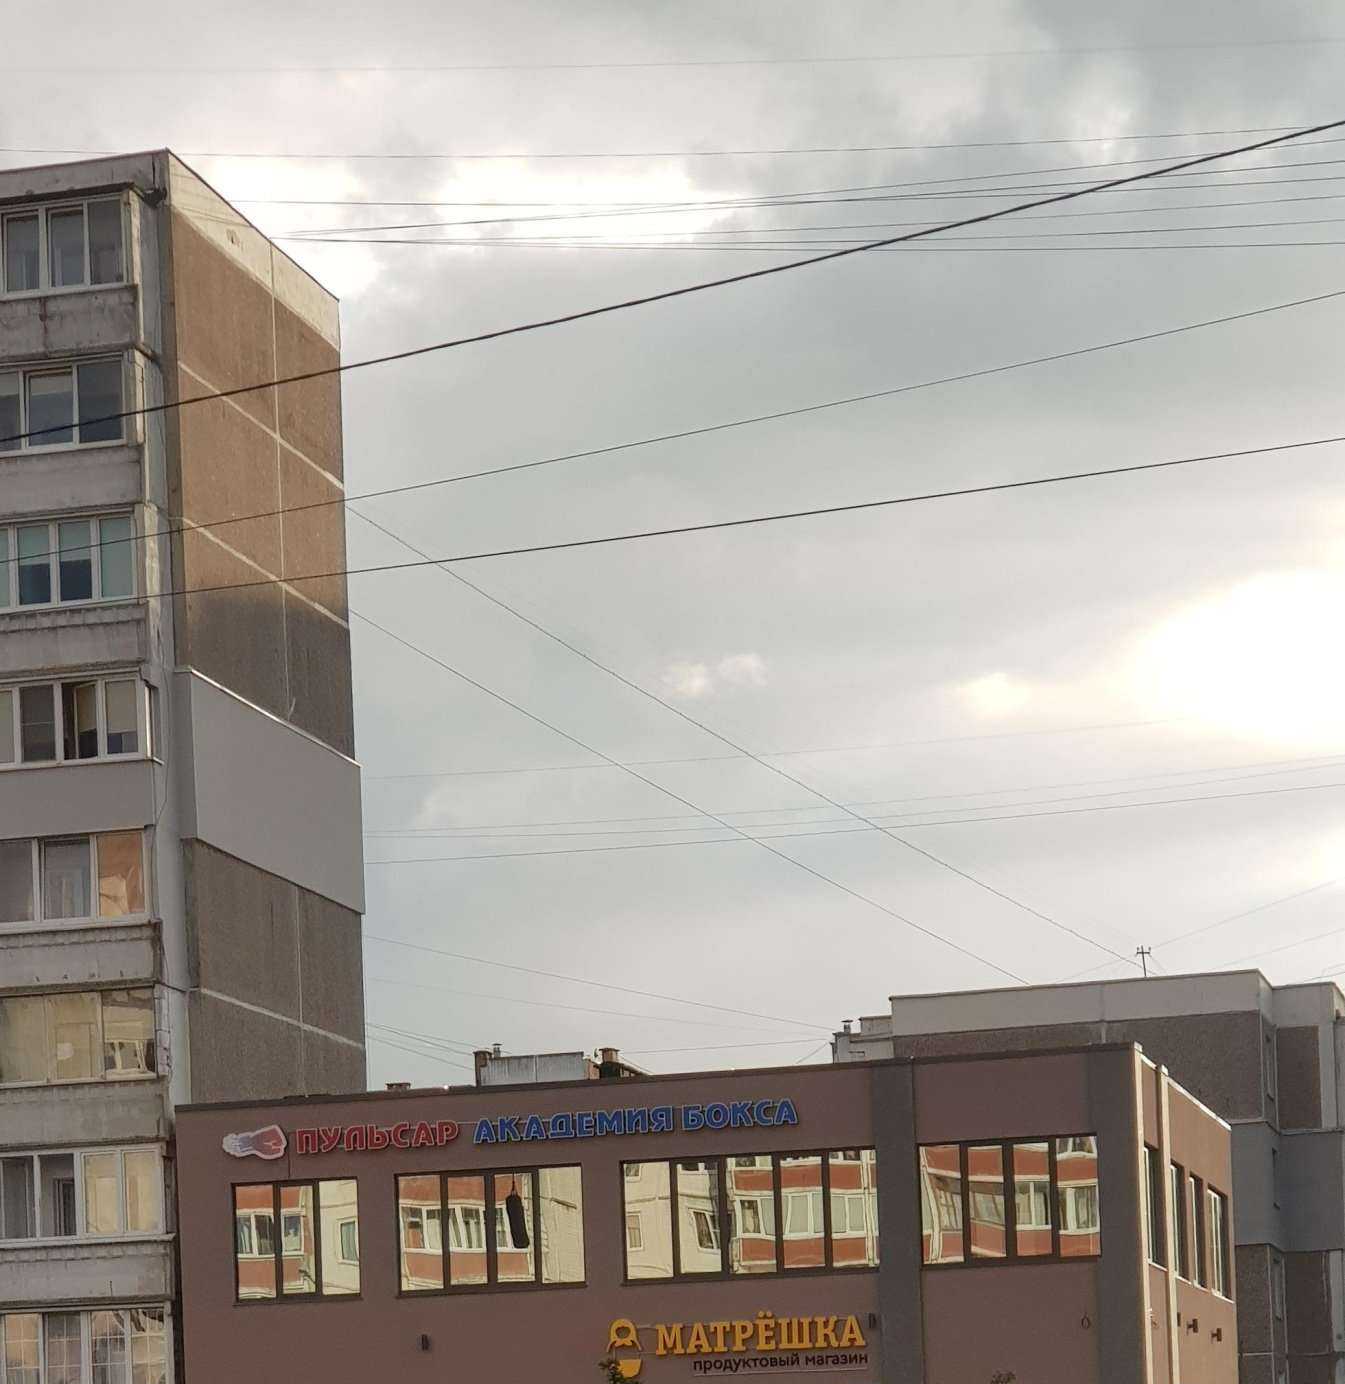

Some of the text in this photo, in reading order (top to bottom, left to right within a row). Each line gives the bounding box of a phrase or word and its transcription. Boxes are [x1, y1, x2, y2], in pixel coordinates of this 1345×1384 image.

[296, 1098, 798, 1154] ПУЛЬСАР АКАДЕМИЯ БОКСА
[655, 1311, 866, 1355] МАТРЁШКА
[693, 1352, 868, 1374] продуктовый магазин
